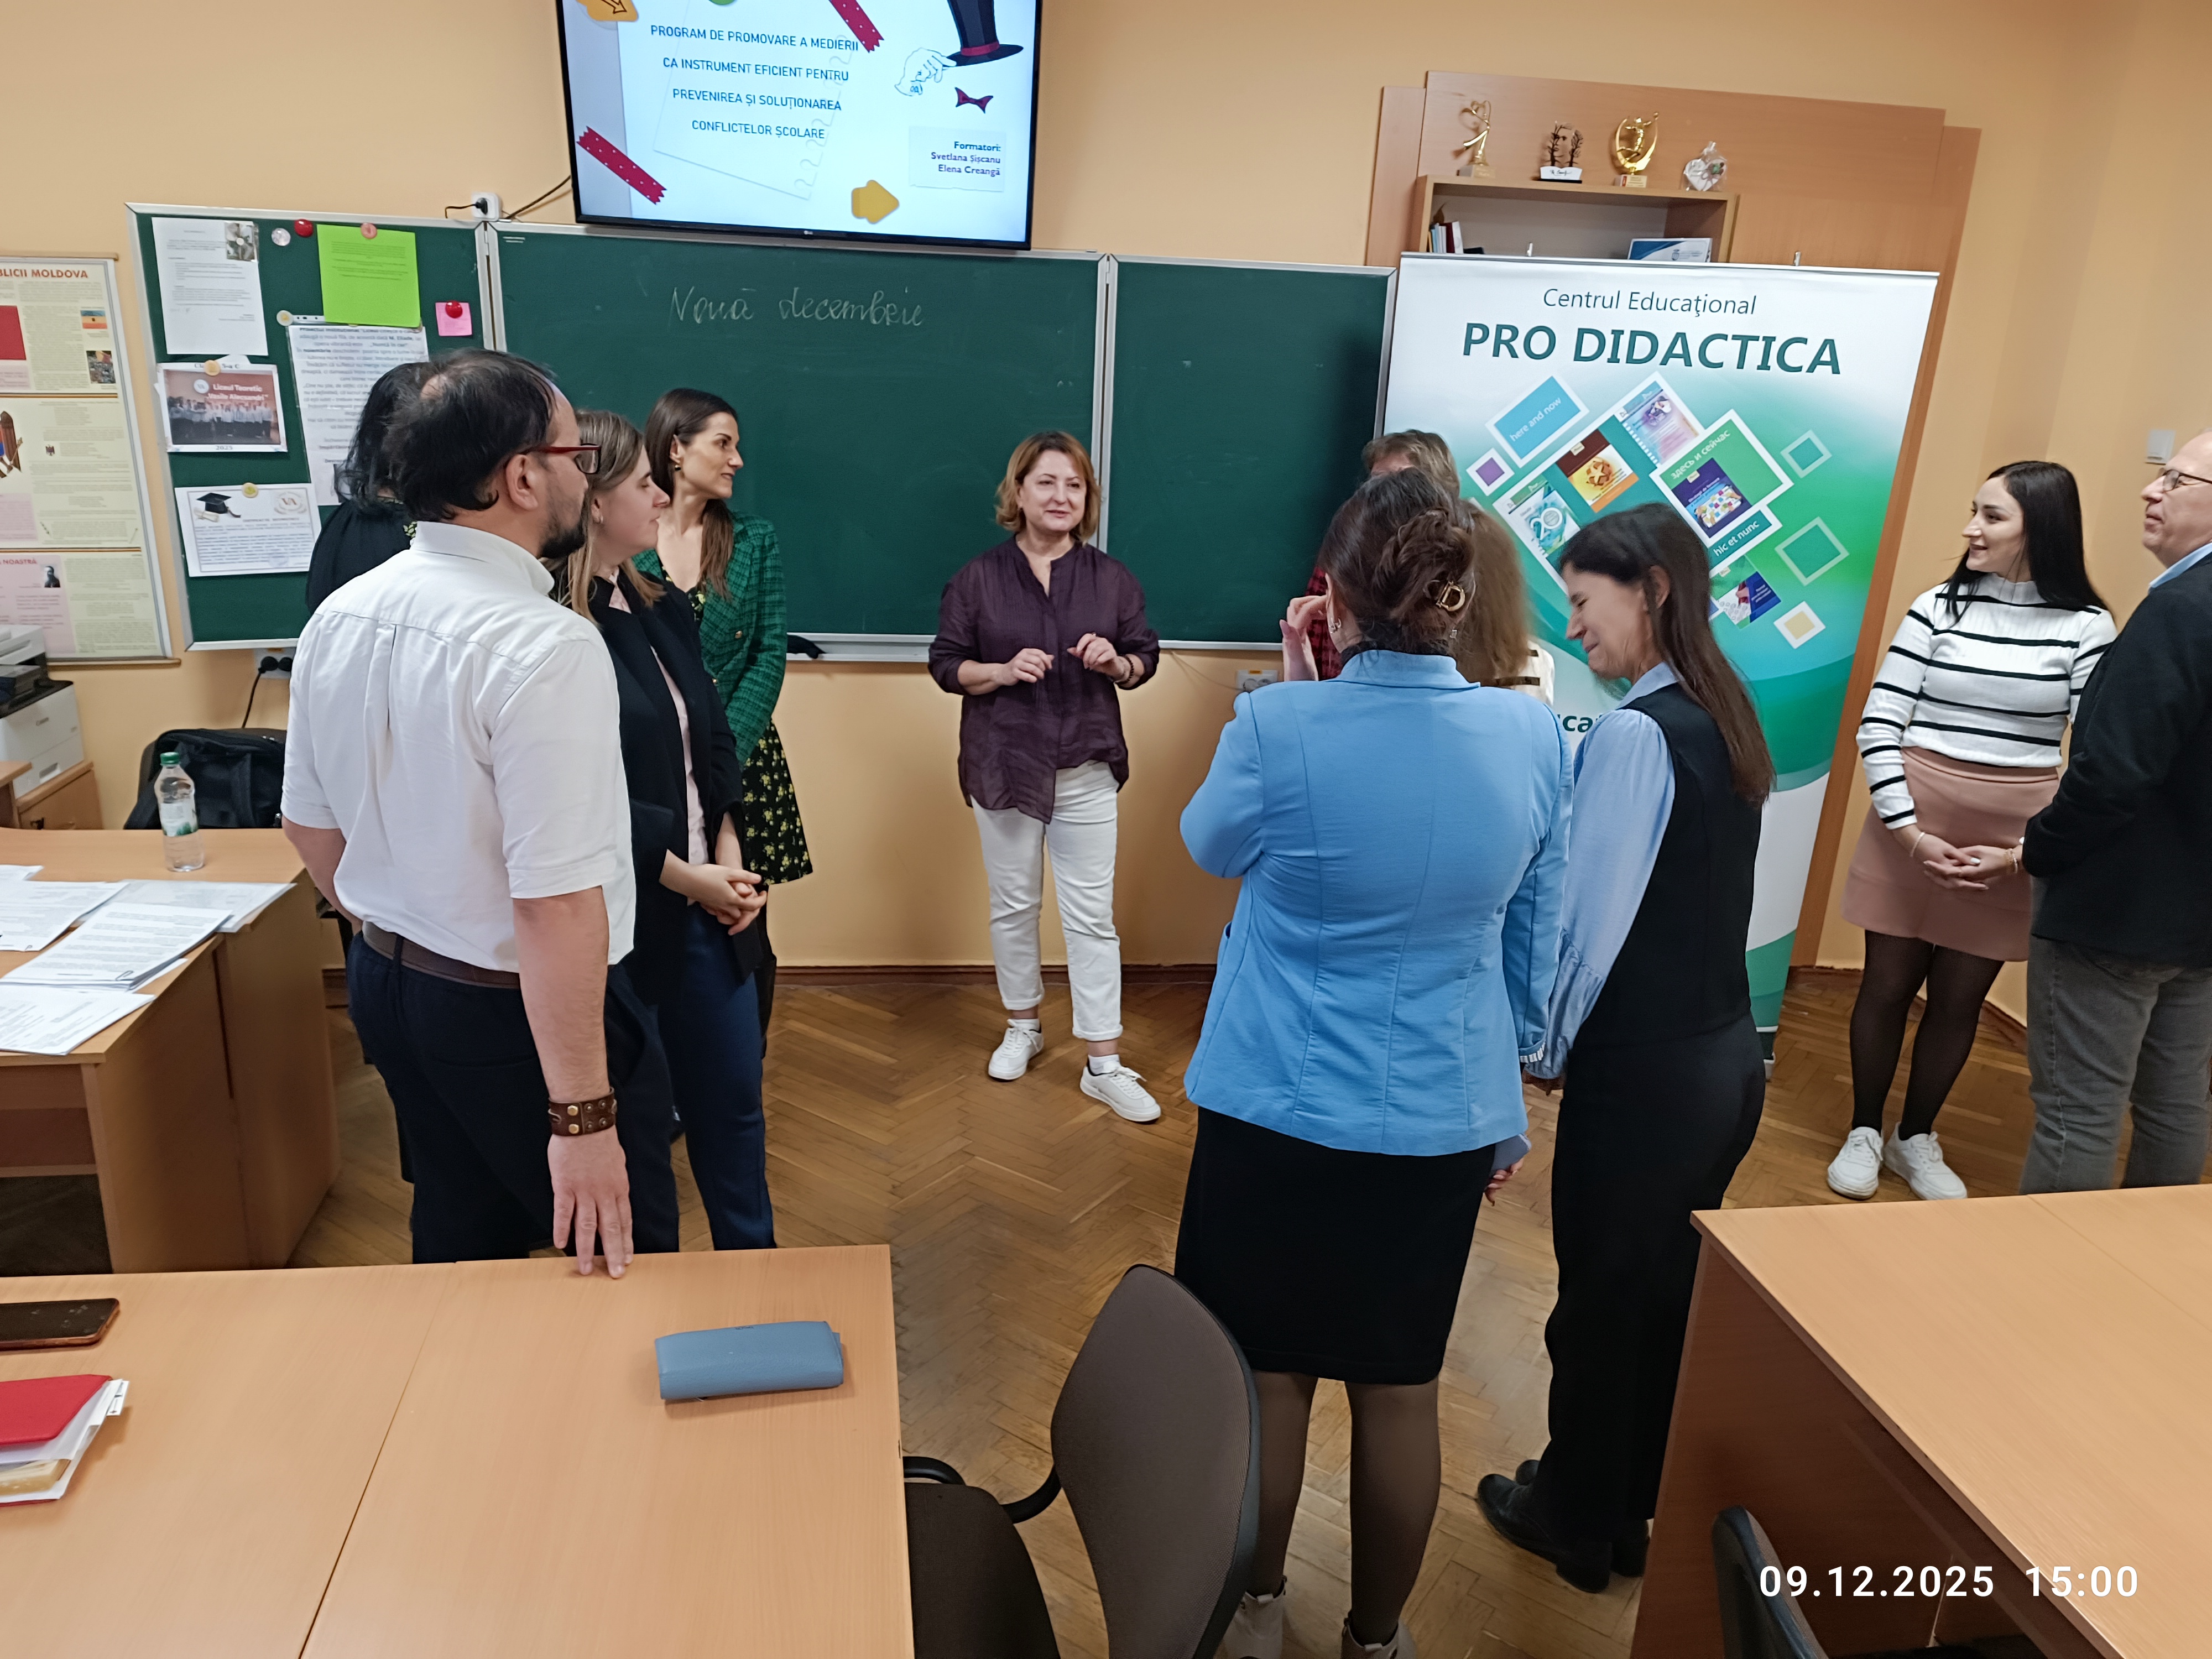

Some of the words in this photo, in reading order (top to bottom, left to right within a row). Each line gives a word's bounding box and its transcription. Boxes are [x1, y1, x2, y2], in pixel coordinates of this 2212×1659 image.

[650, 24, 706, 40] PROGRAM
[710, 29, 724, 41] DE
[728, 31, 796, 46] PROMOVARE
[800, 36, 808, 48] A
[811, 38, 858, 51] MEDIERII
[663, 57, 678, 68] CA
[681, 59, 752, 74] INSTRUMENT
[755, 64, 802, 77] EFICIENT
[806, 68, 849, 81] PENTRU
[673, 88, 742, 103] PREVENIREA
[745, 94, 755, 107] ȘI
[760, 95, 842, 111] SOLUȚIONAREA
[692, 120, 772, 135] CONFLICTELOR
[775, 126, 825, 139] ȘCOLARE
[931, 152, 967, 161] Svetlana
[954, 141, 1001, 152] Formatori:
[938, 164, 962, 173] Elena
[964, 166, 1000, 177] Creangă
[32, 269, 88, 278] MOLDOVA
[668, 285, 757, 326] Nouă
[1543, 288, 1620, 310] Centrul
[1463, 322, 1557, 360] PRO
[1573, 327, 1841, 375] DIDACTICA
[1510, 423, 1530, 442] here
[1528, 411, 1545, 428] and
[1543, 397, 1562, 412] now
[1671, 459, 1695, 480] здесь
[1694, 453, 1702, 462] и
[1700, 430, 1731, 456] сейчас
[1713, 542, 1729, 557] hic
[1728, 535, 1739, 547] et
[1737, 520, 1760, 540] nunc
